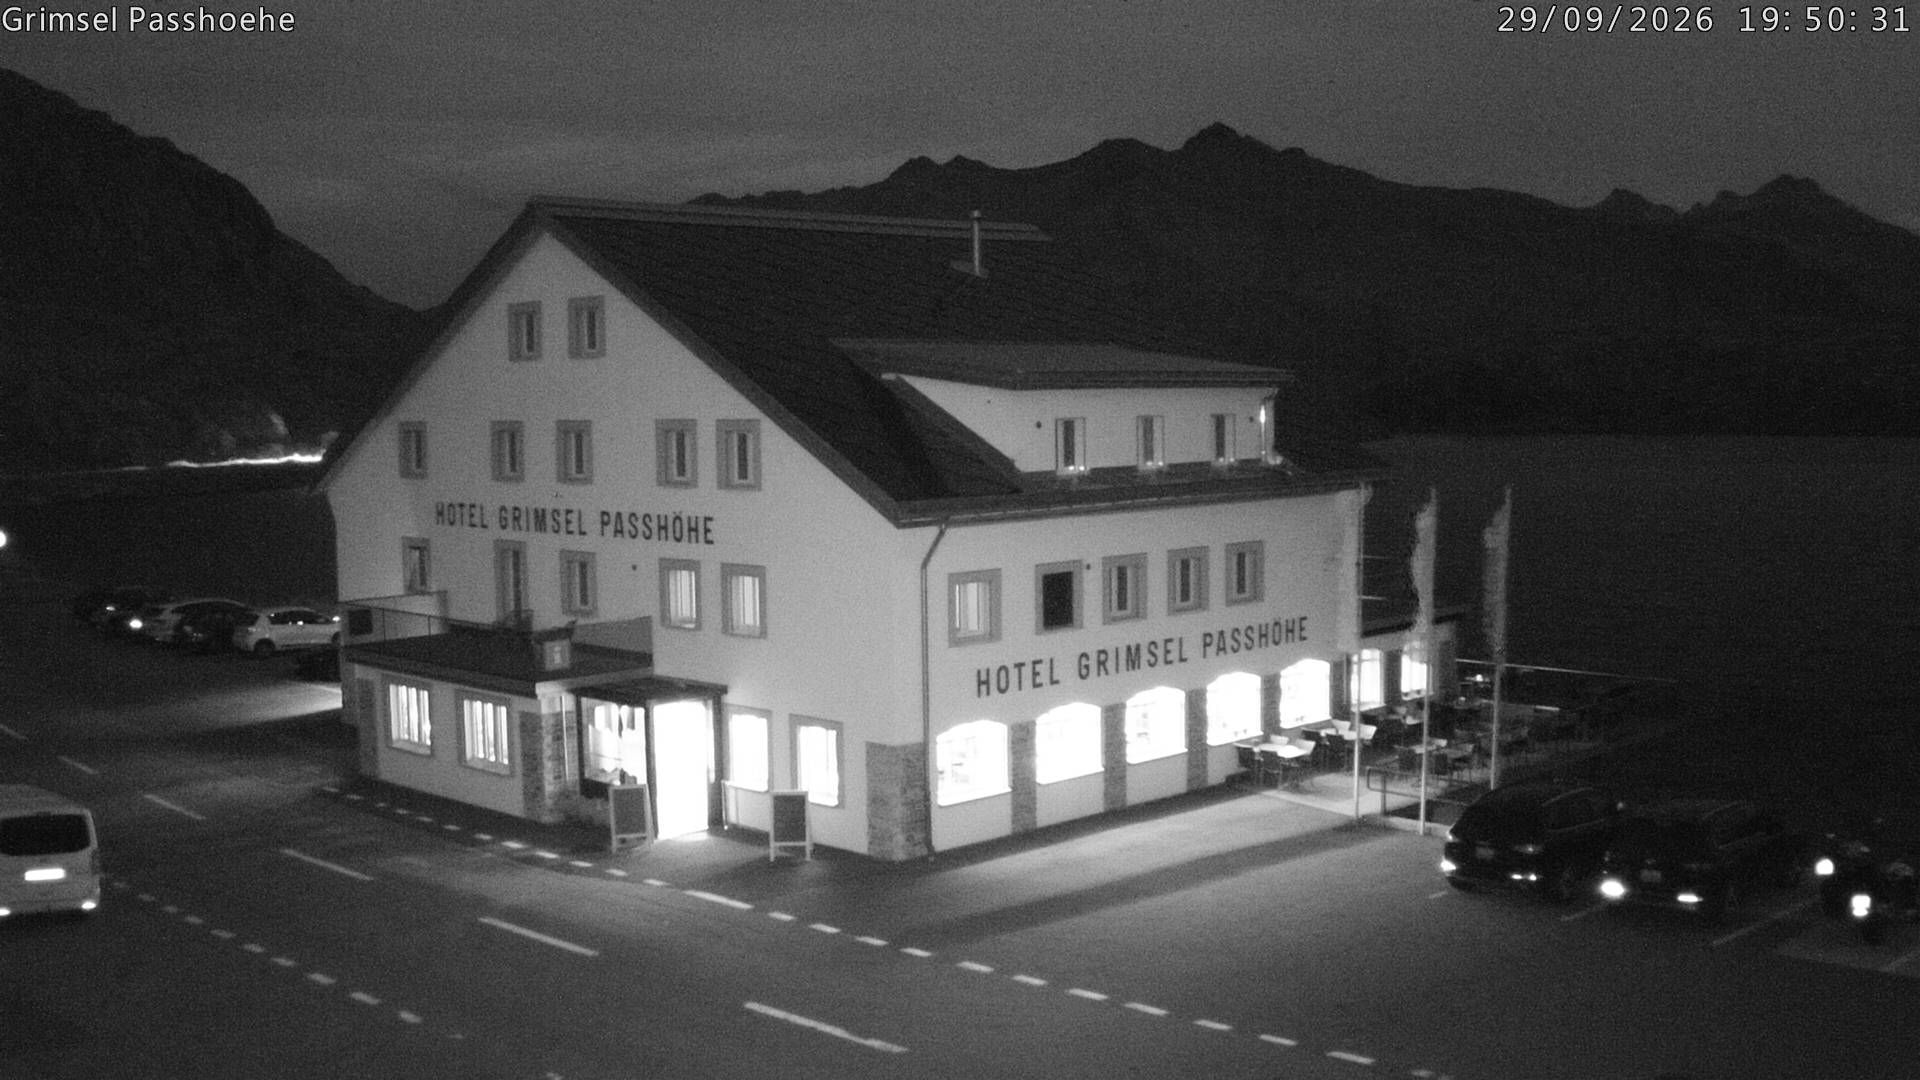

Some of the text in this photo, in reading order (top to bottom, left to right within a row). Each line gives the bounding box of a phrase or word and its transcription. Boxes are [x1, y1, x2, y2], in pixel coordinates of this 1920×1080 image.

[435, 502, 714, 545] HOTEL GRIMSEL PASSHÖHE
[976, 616, 1308, 698] HOTEL GRIMSEL PASSHÖHE
